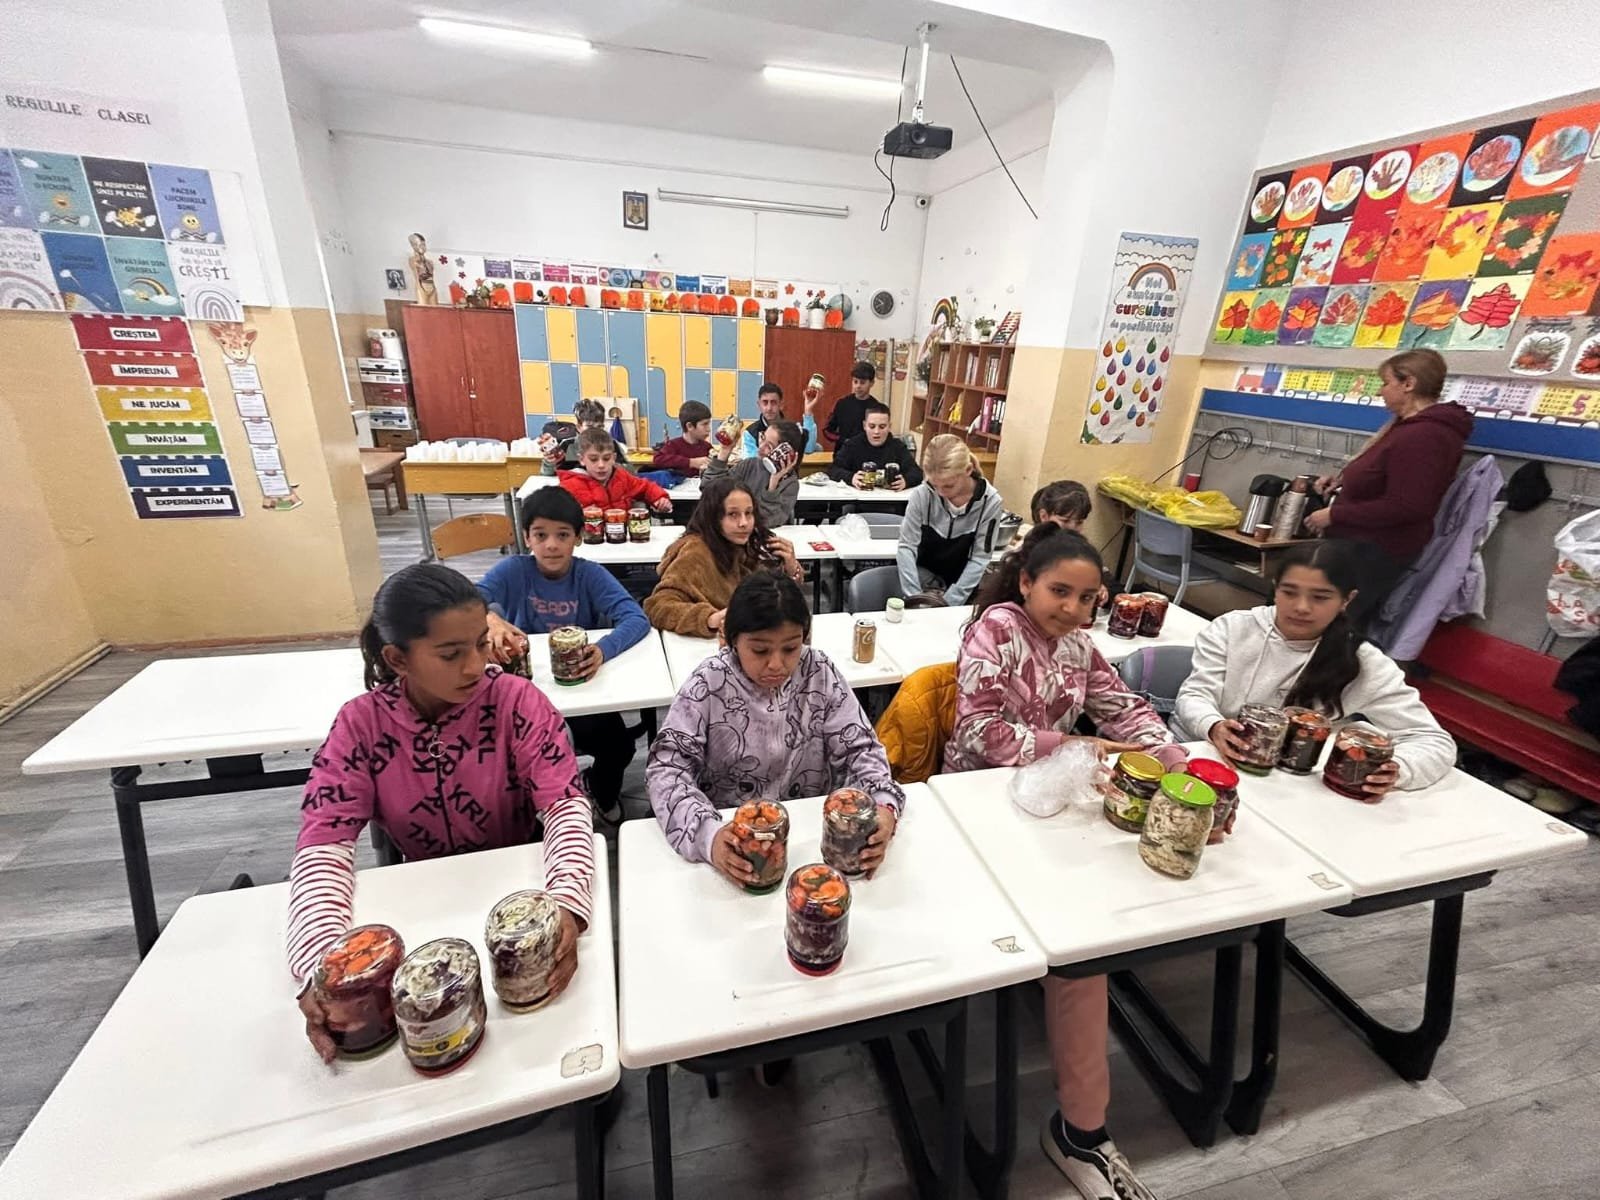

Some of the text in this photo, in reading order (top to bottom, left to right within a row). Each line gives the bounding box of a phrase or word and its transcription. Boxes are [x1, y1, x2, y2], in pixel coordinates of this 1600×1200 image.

[5, 94, 151, 125] REGULILE CLASEI
[179, 265, 231, 282] CREȘTI
[1115, 301, 1176, 317] curcubeu
[113, 329, 157, 339] CREȘTEM
[149, 400, 180, 408] JUCĂM
[1480, 387, 1500, 406] 4
[1572, 394, 1591, 416] 5
[155, 497, 224, 505] EXPERIMENTĂM
[301, 782, 359, 811] KRL
[447, 783, 492, 834] KRL
